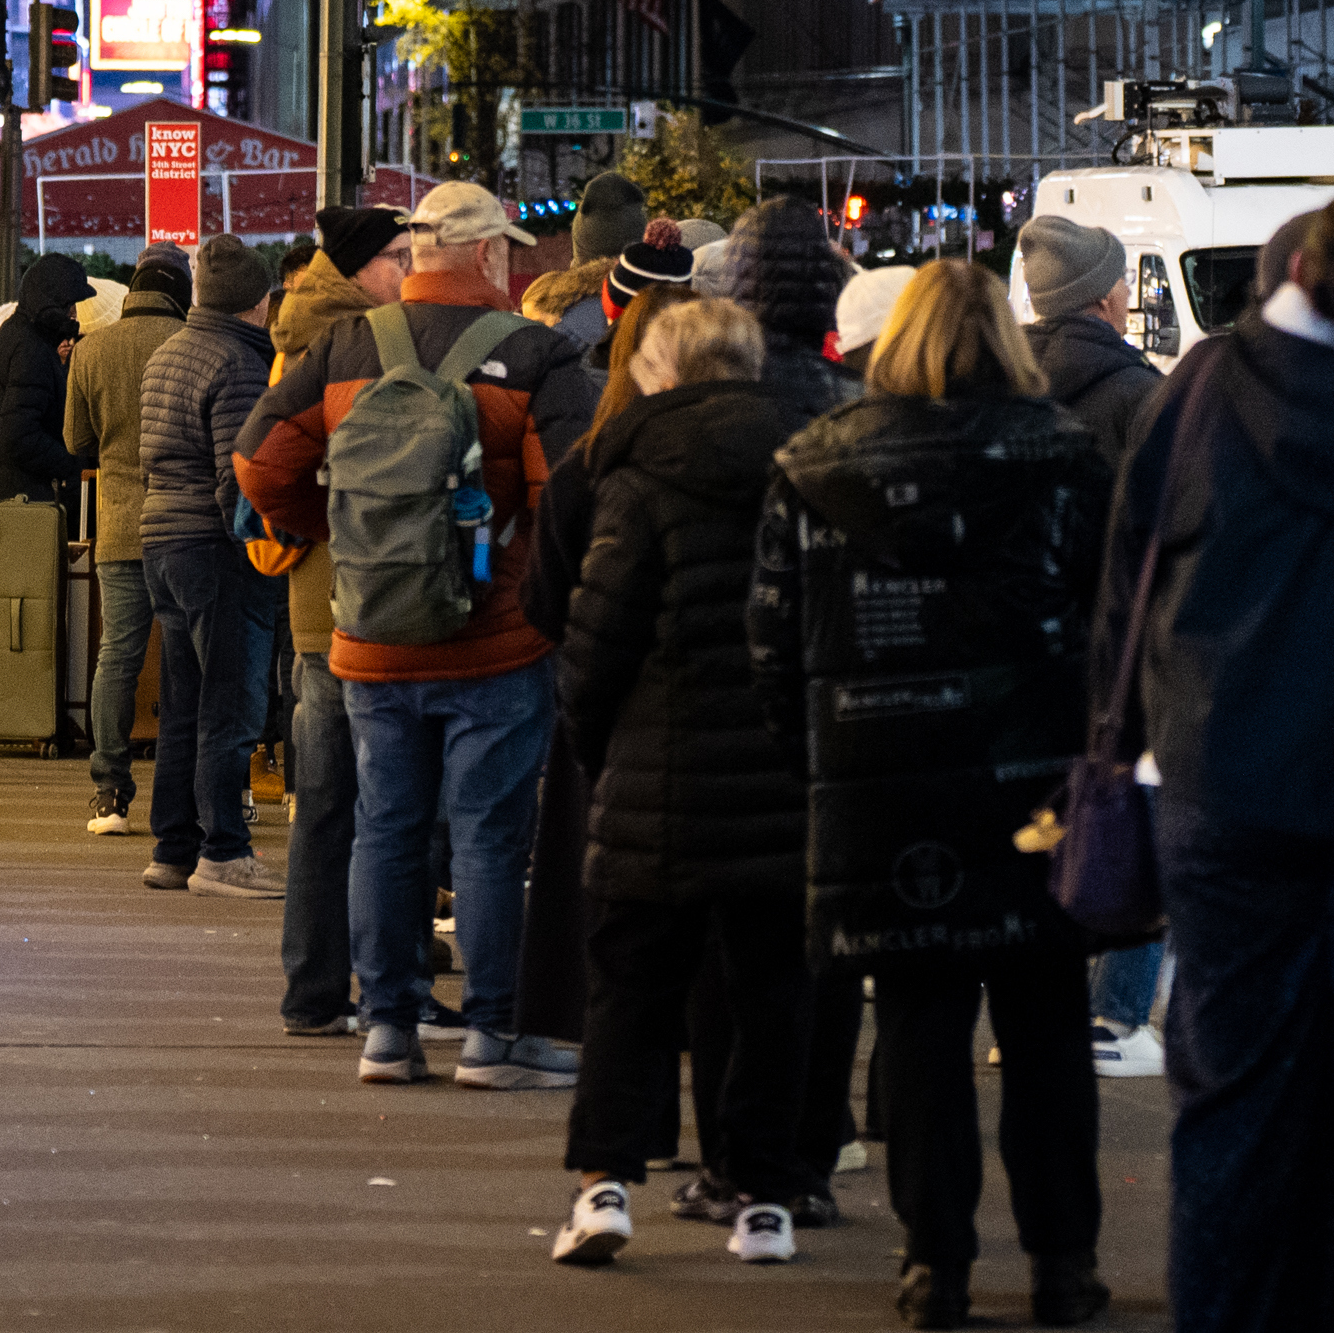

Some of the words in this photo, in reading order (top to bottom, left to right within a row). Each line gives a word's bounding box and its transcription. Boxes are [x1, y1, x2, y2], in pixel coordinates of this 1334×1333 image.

[544, 113, 557, 128] W
[587, 113, 601, 128] St
[151, 127, 196, 140] know
[151, 141, 196, 157] NYC
[23, 136, 117, 177] Herald
[240, 138, 299, 171] Bar
[152, 161, 169, 169] 34th
[171, 161, 196, 169] Street
[152, 169, 196, 179] district
[152, 229, 196, 243] Macy's
